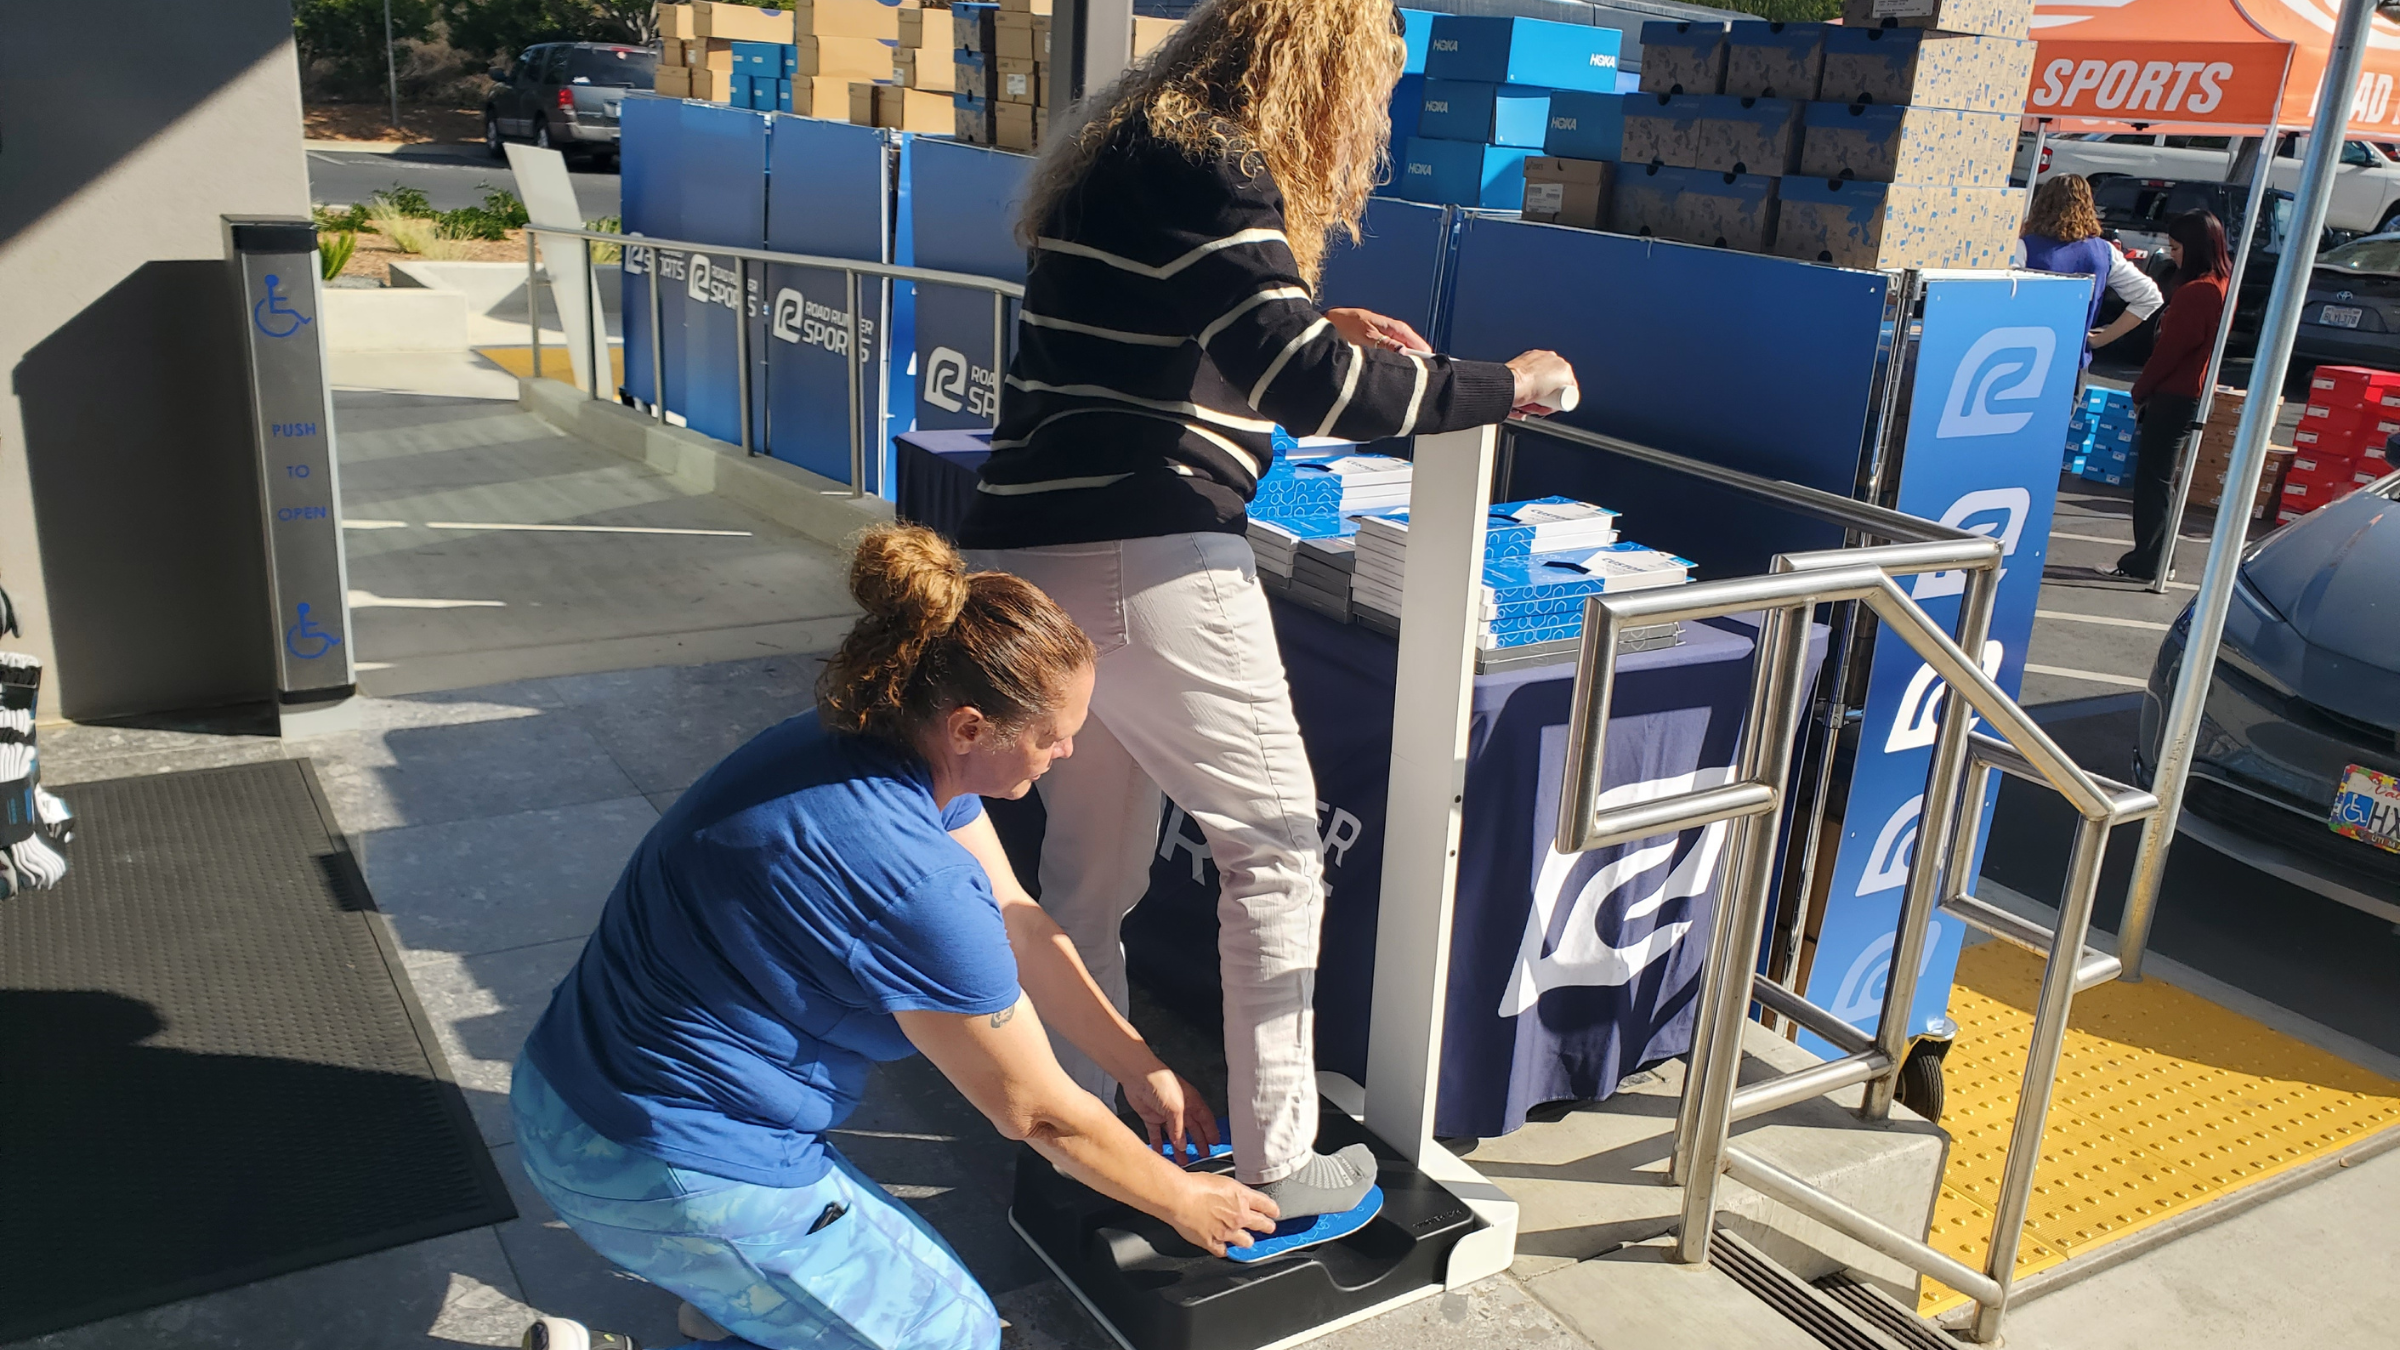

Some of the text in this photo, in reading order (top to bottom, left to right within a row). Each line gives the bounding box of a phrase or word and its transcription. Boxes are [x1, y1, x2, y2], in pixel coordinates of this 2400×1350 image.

[1433, 39, 1458, 52] HOKA
[1590, 53, 1616, 68] HOKA
[2032, 58, 2234, 114] SPORTS
[1425, 100, 1448, 113] HOKA
[1551, 117, 1577, 131] HOKA
[1408, 163, 1432, 176] HOKA
[709, 281, 758, 317] SPORS
[805, 301, 874, 335] ROAD RUNER
[802, 319, 872, 363] SPORS
[970, 365, 995, 388] ROA
[271, 422, 317, 438] PUSH
[286, 464, 310, 479] TO
[277, 505, 327, 522] OPEN
